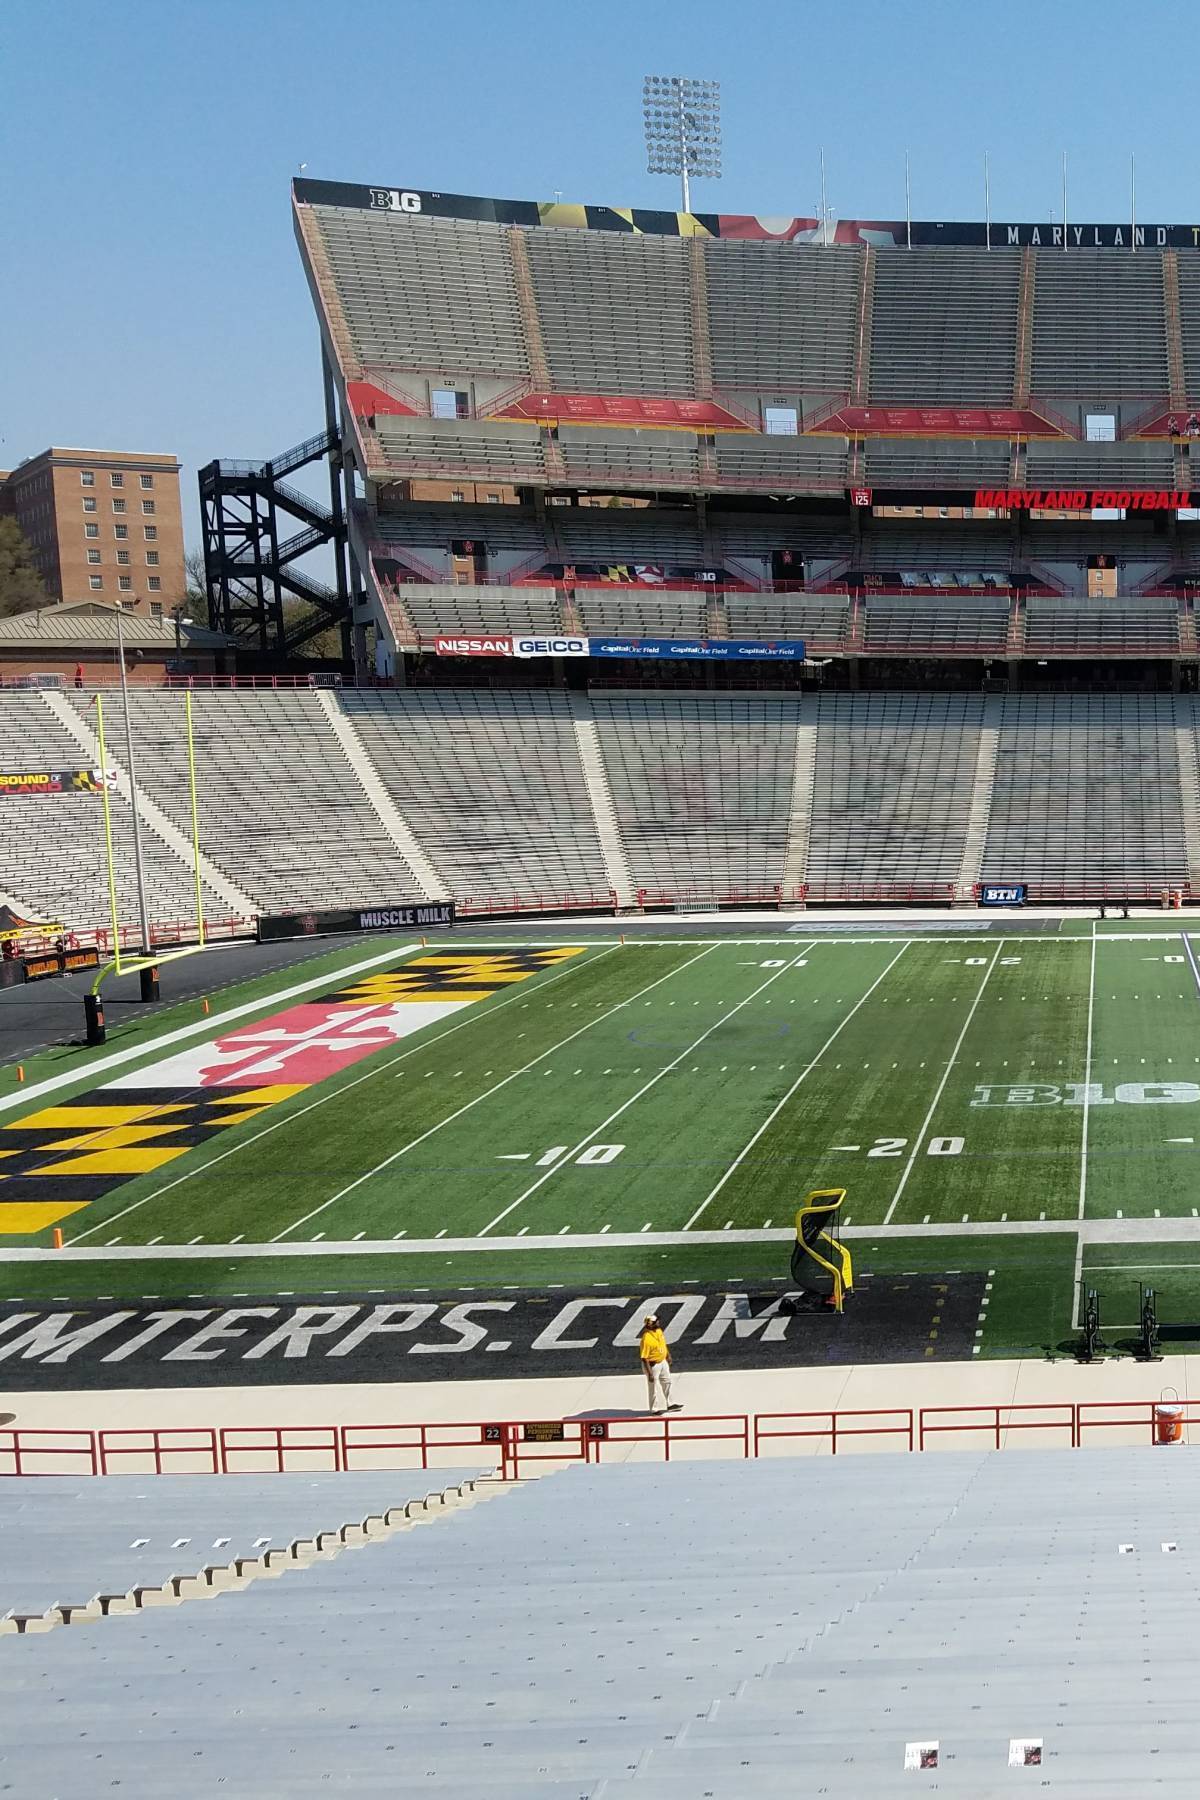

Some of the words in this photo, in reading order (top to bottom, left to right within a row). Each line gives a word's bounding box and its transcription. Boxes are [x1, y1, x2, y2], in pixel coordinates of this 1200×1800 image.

[1007, 226, 1167, 246] MARYLAND
[855, 495, 869, 505] 125
[974, 489, 1087, 509] MARYLAND
[1090, 490, 1192, 509] FOOTBALL
[438, 640, 509, 651] NISSAN
[519, 641, 583, 652] GEICO
[0, 774, 48, 786] SOUND
[986, 888, 1018, 900] BTN
[360, 908, 414, 928] MUSCLE
[417, 906, 451, 923] MILK
[486, 1428, 500, 1439] 22
[590, 1425, 604, 1436] 23
